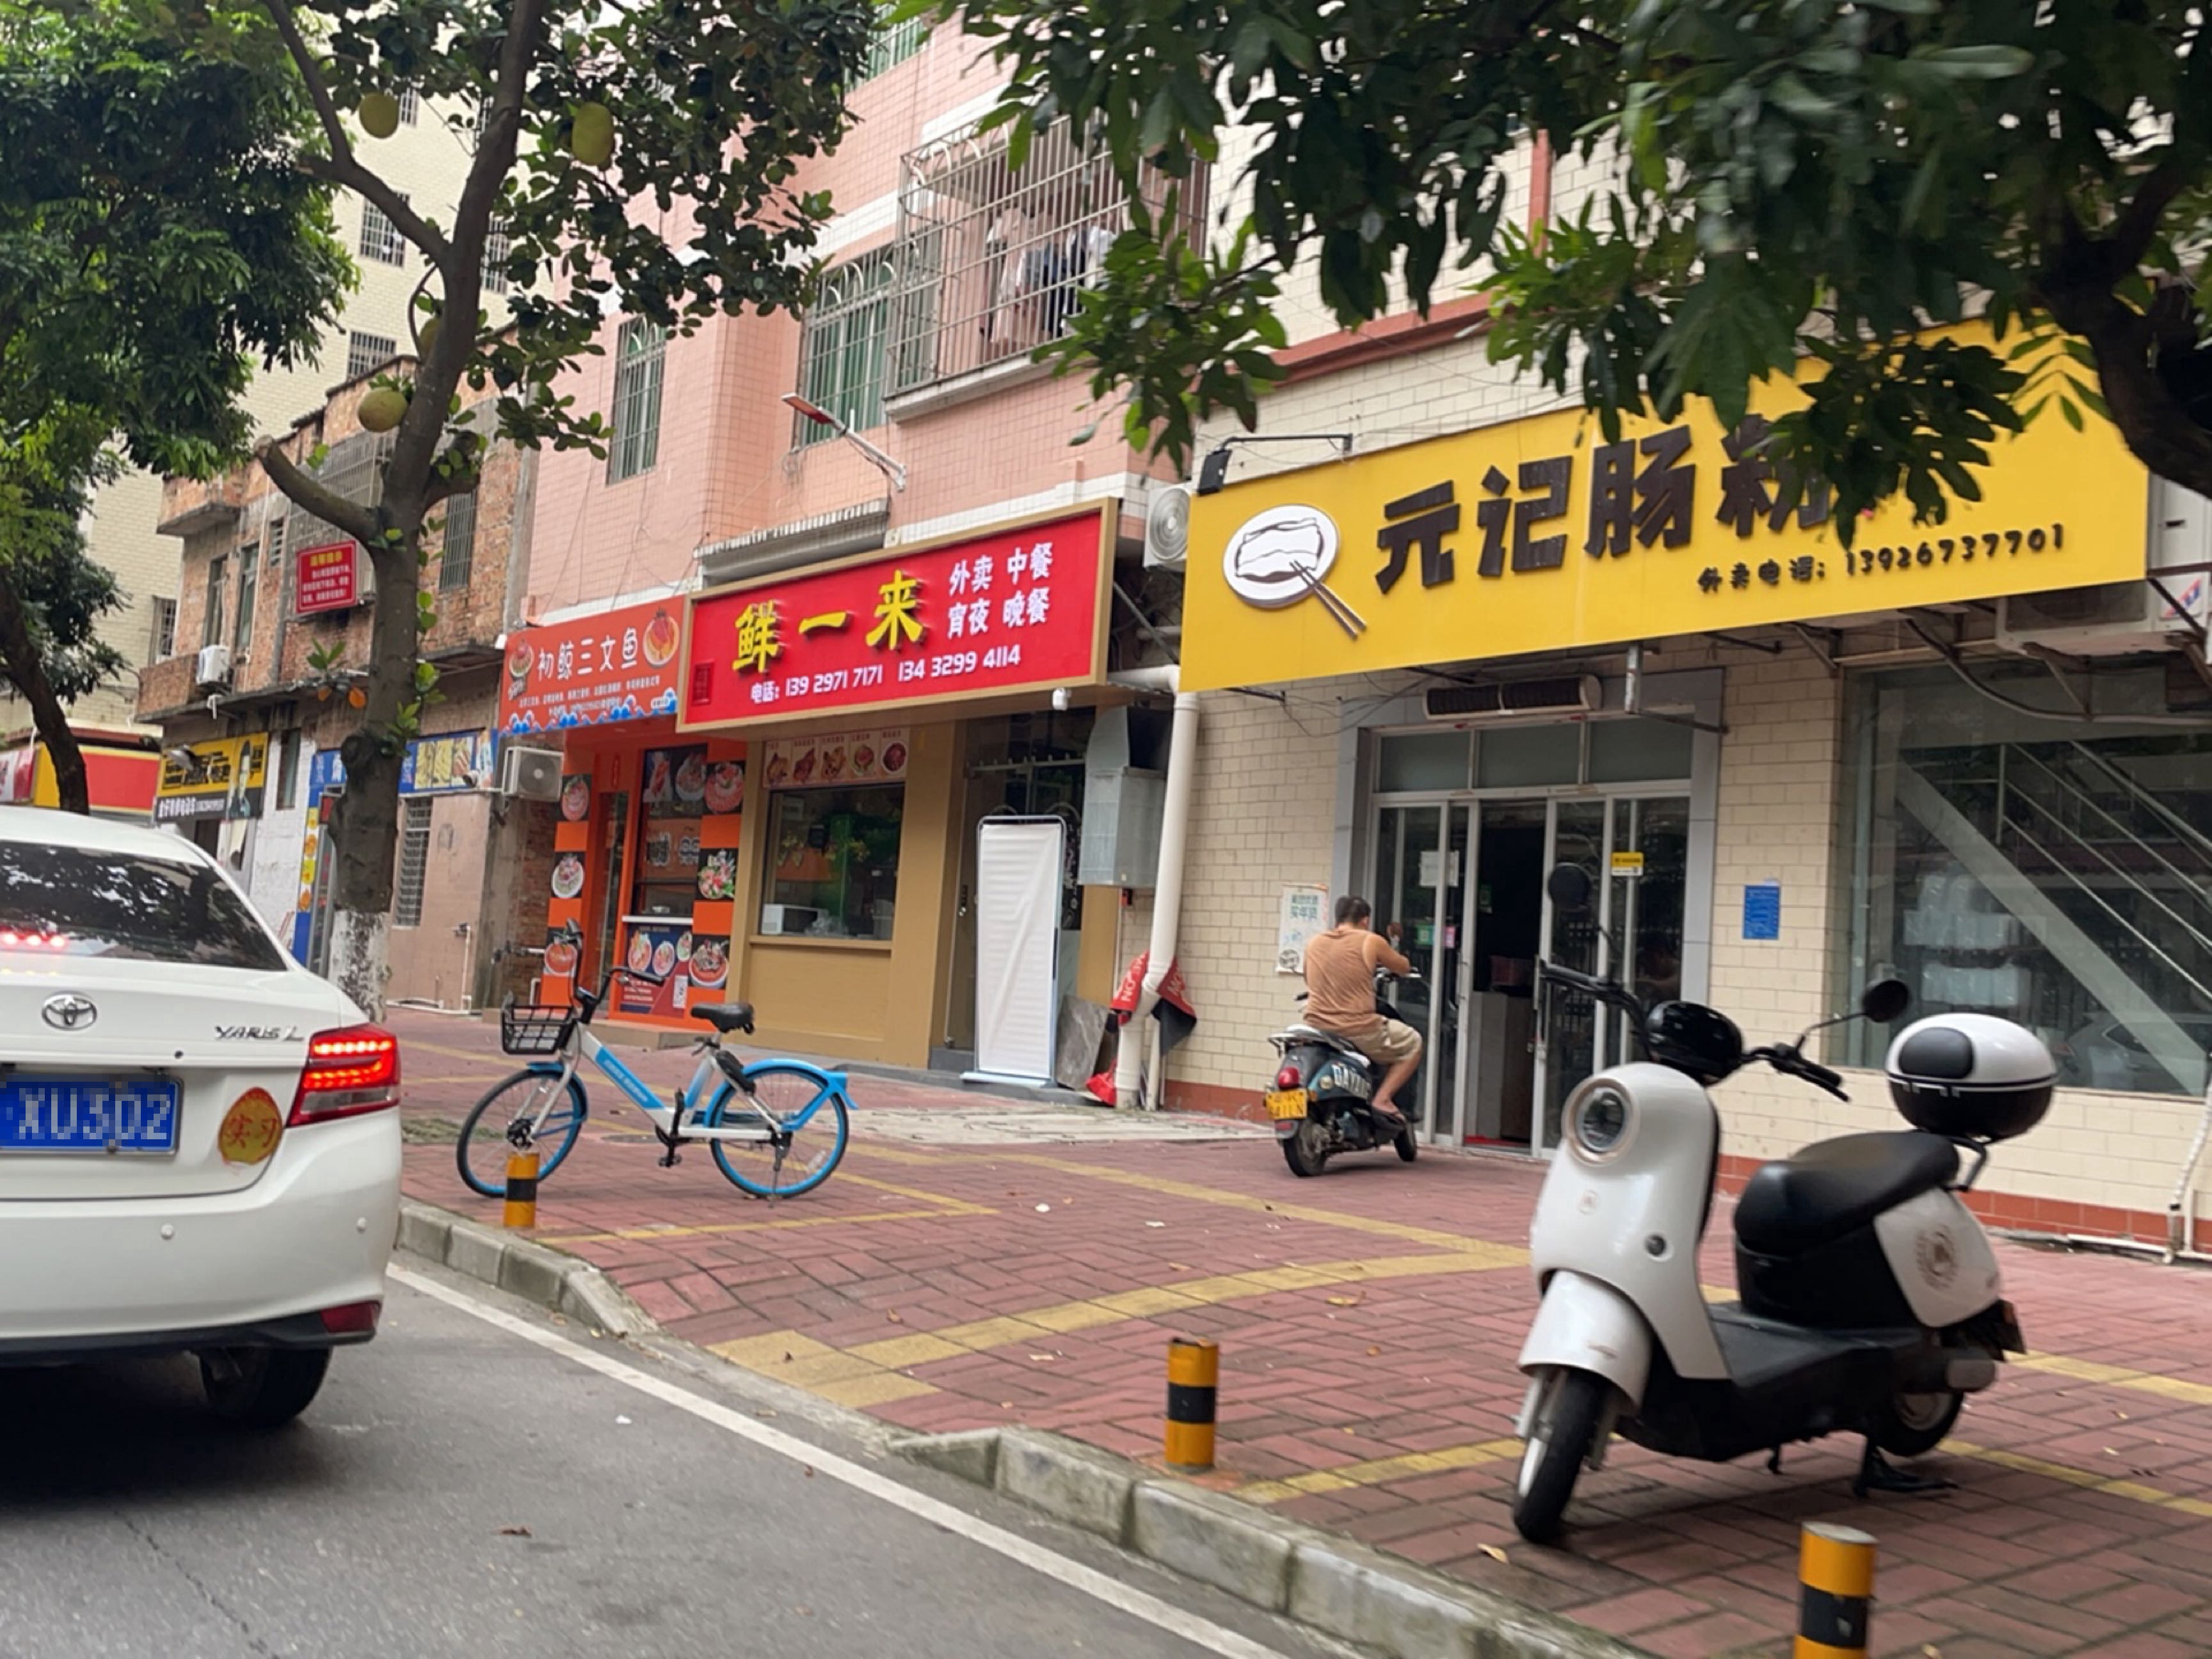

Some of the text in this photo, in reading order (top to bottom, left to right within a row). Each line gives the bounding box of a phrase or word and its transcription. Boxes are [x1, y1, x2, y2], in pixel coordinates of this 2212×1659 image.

[1375, 413, 1836, 595] 元记肠粉
[950, 542, 1053, 597] 外卖 中餐
[1846, 522, 2064, 576] 13926737701
[733, 569, 924, 673] 鲜一来
[948, 587, 1050, 639] 宵夜 晚餐
[751, 645, 1021, 704] 电话: 139 2971 7171 134 3299 4114
[215, 1025, 305, 1042] YARIS L
[224, 1113, 277, 1148] 实习
